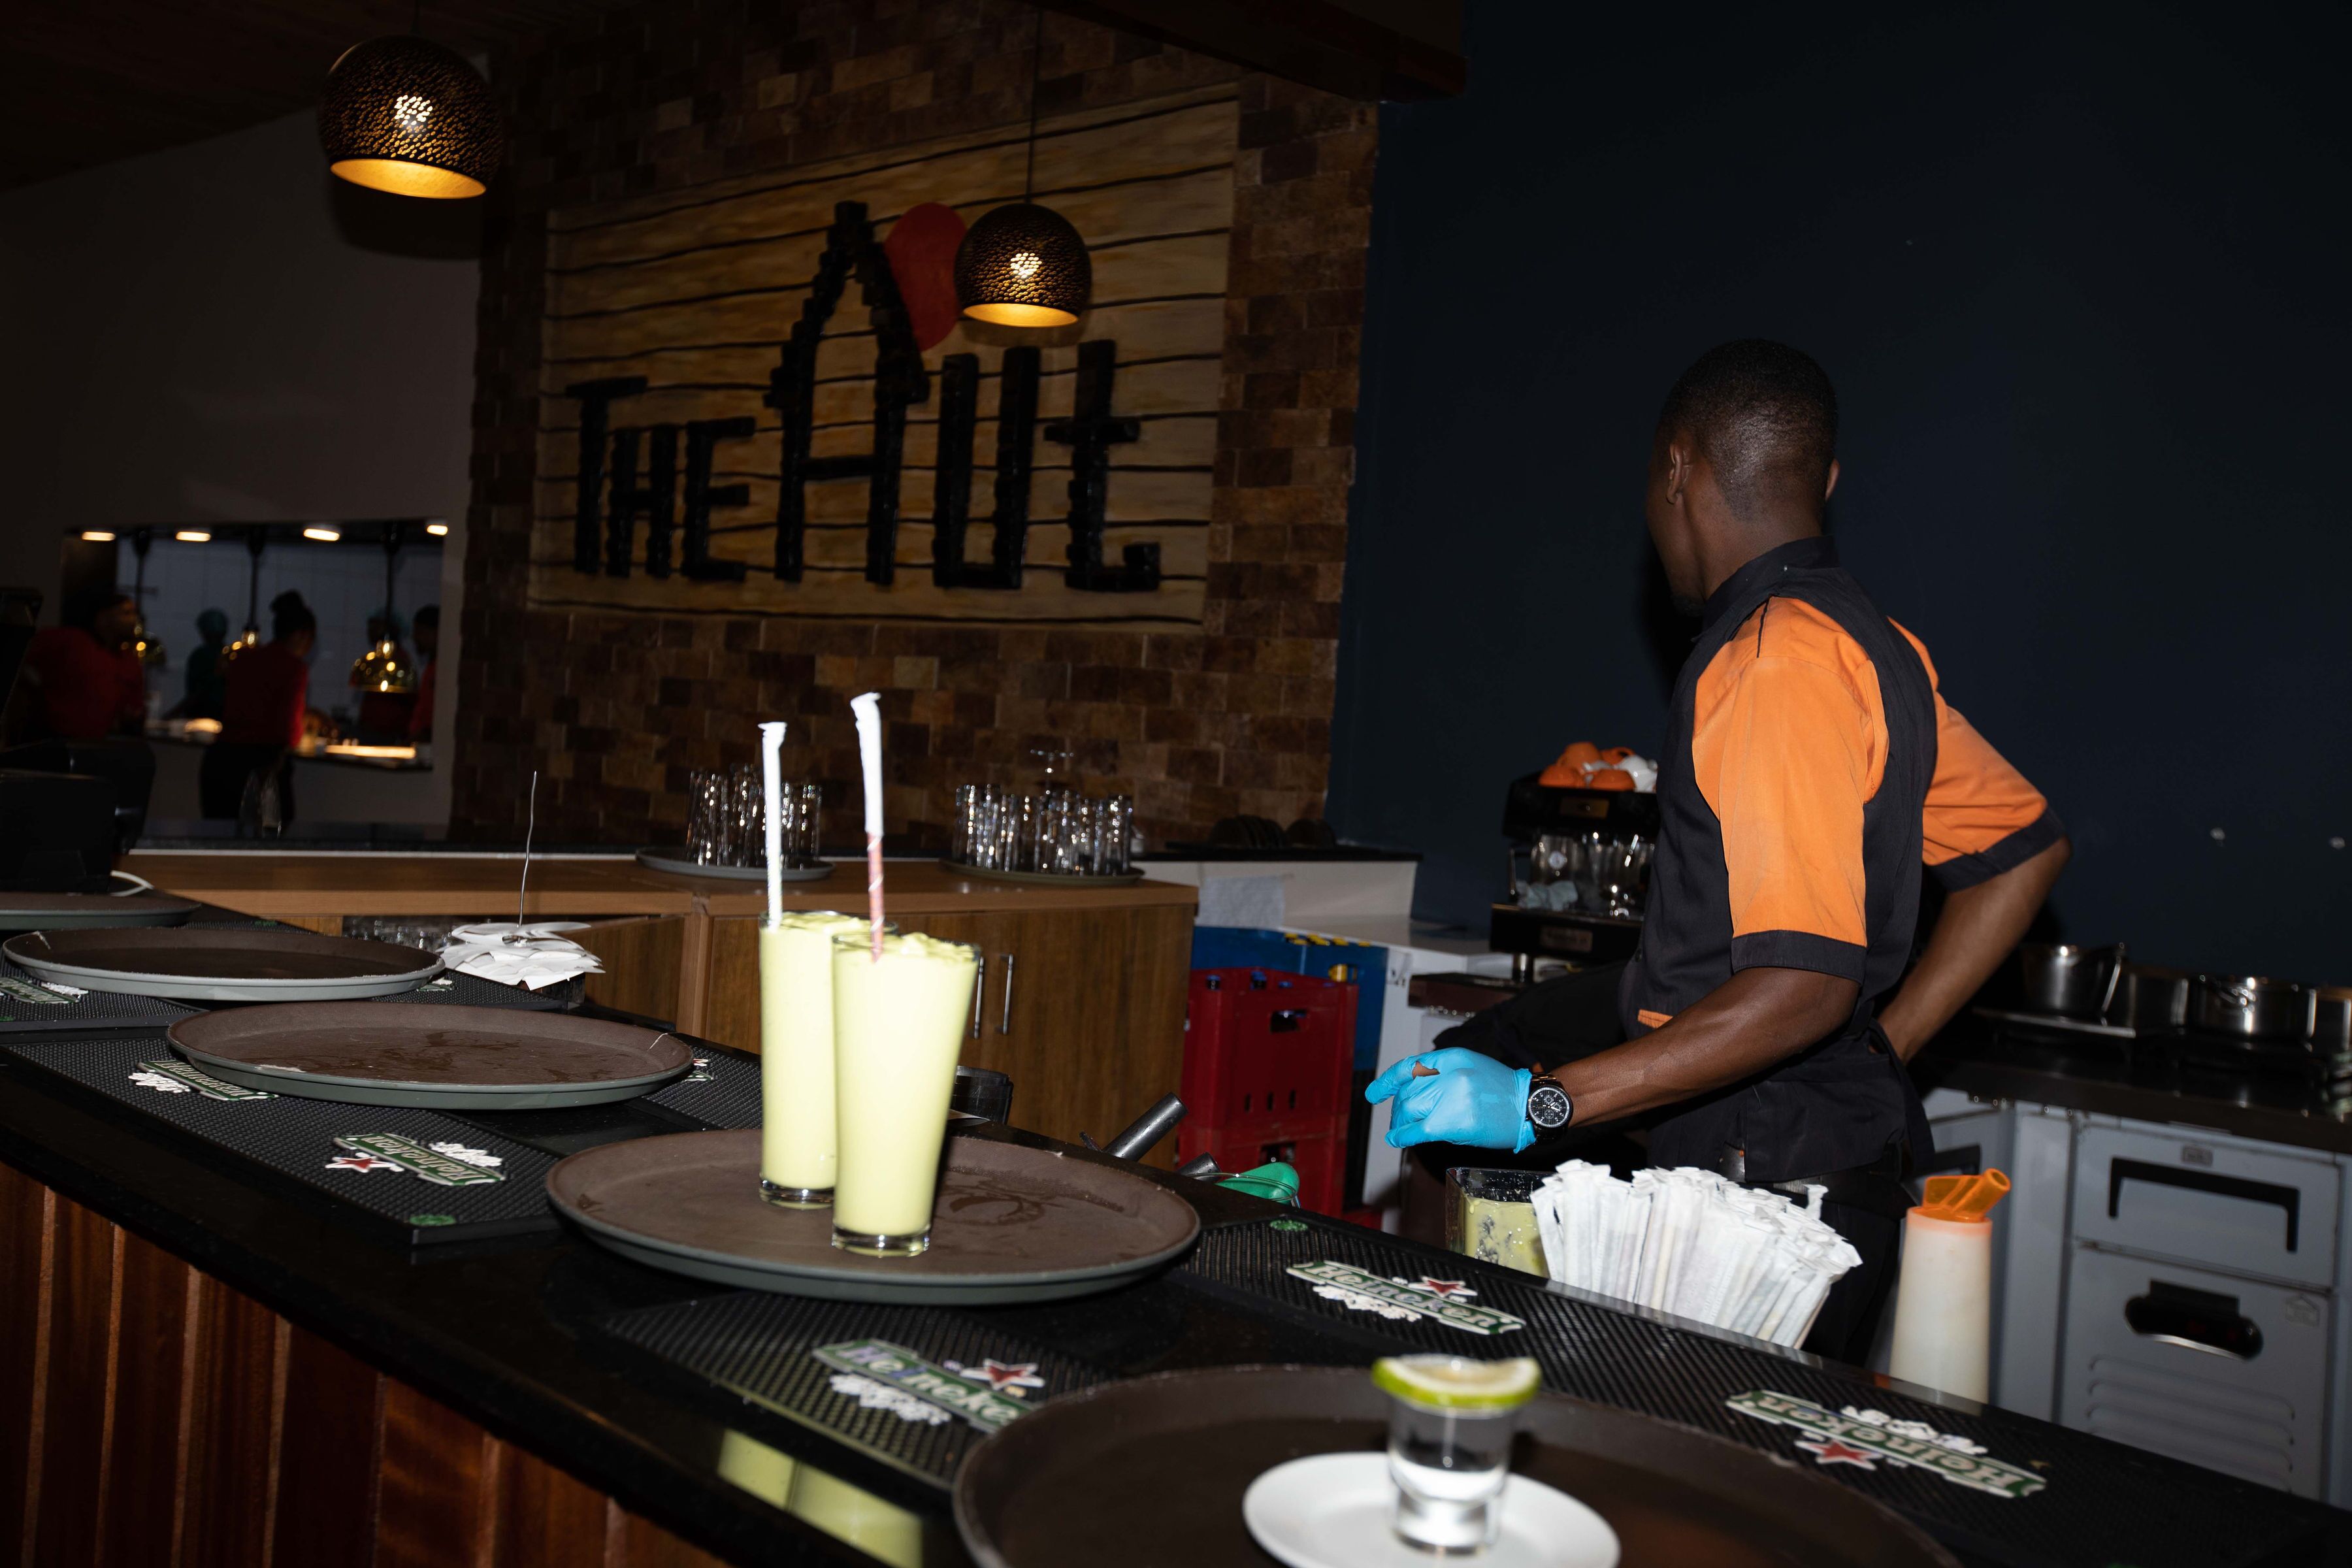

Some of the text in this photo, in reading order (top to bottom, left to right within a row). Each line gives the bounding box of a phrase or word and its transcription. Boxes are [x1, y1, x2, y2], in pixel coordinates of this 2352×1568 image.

[566, 376, 755, 580] THE
[360, 1135, 488, 1181] Heineken
[1309, 1264, 1497, 1328] Heineken
[836, 1345, 1020, 1423] Heineke
[1756, 1395, 2018, 1490] Heineken
